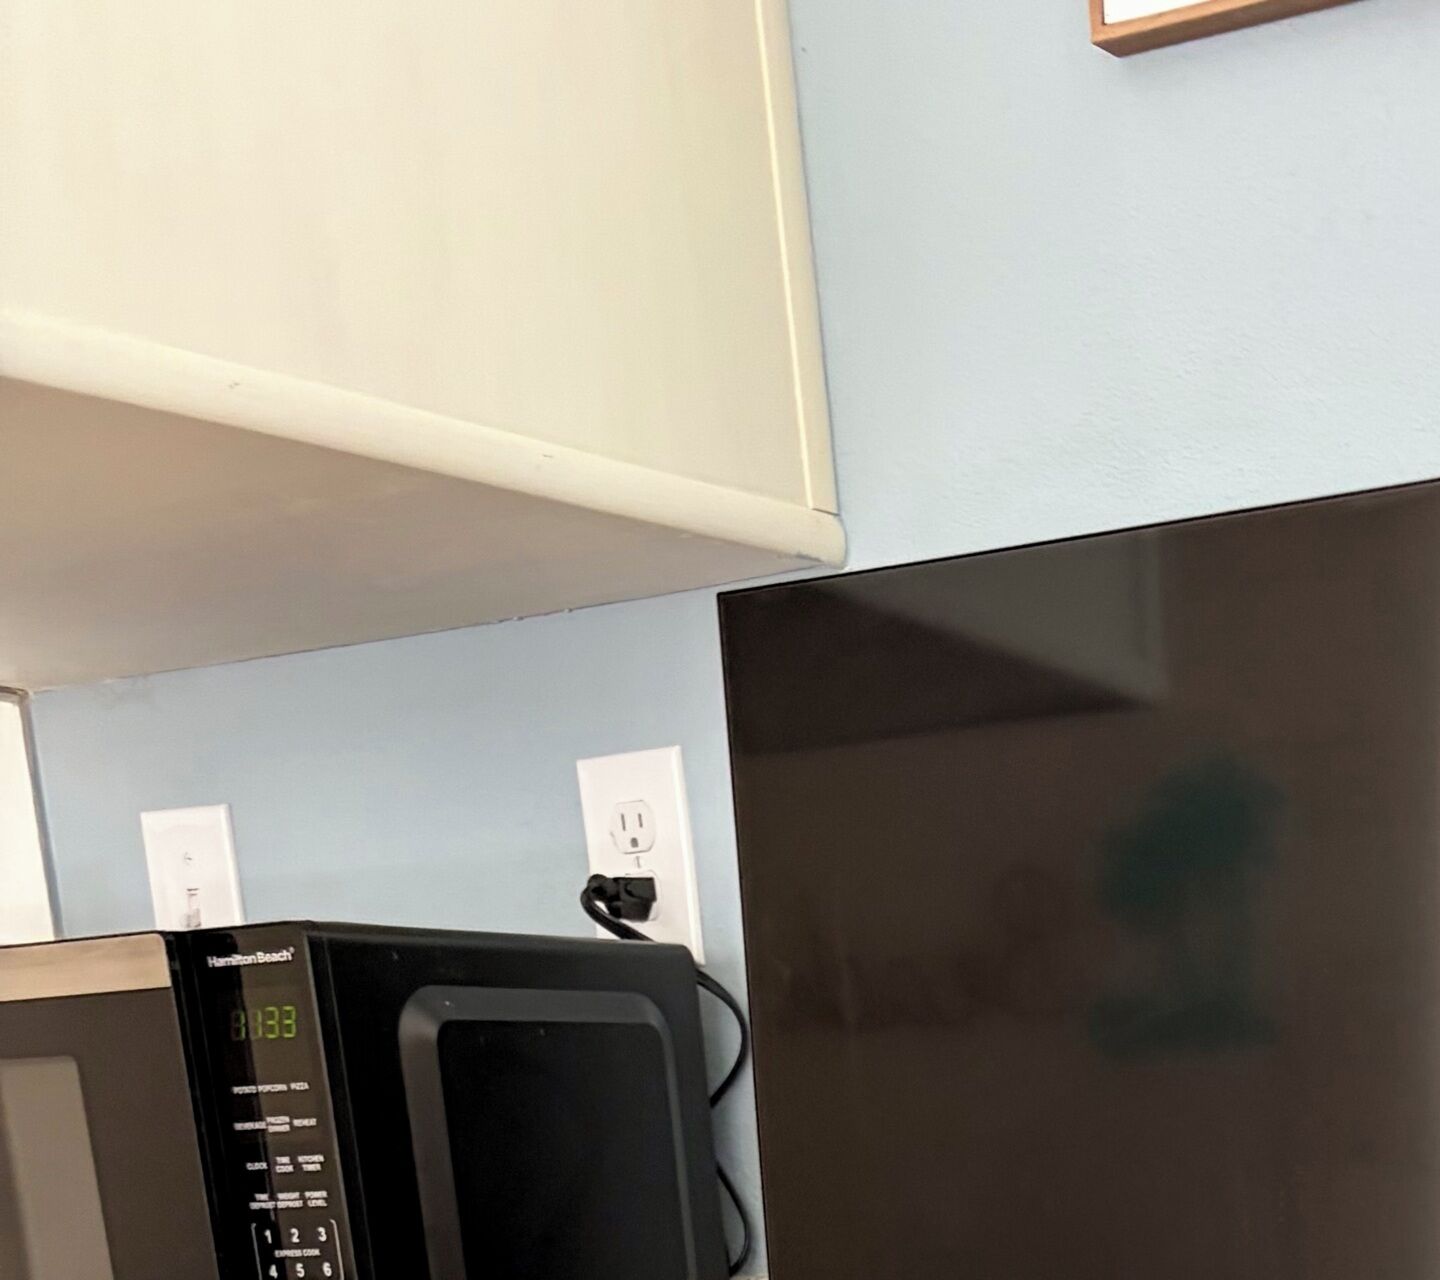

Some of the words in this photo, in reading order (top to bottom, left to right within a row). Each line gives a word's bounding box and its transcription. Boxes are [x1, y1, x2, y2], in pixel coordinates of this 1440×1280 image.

[207, 953, 257, 967] Hamilton
[256, 949, 292, 963] Beach
[246, 1162, 268, 1170] CLOCK
[264, 1229, 273, 1244] 1
[290, 1228, 300, 1243] 2
[317, 1227, 327, 1242] 3
[274, 1249, 303, 1258] EXPRESS
[303, 1248, 321, 1257] COOK
[269, 1264, 278, 1279] 4
[295, 1263, 305, 1278] 5
[322, 1262, 332, 1277] 6
